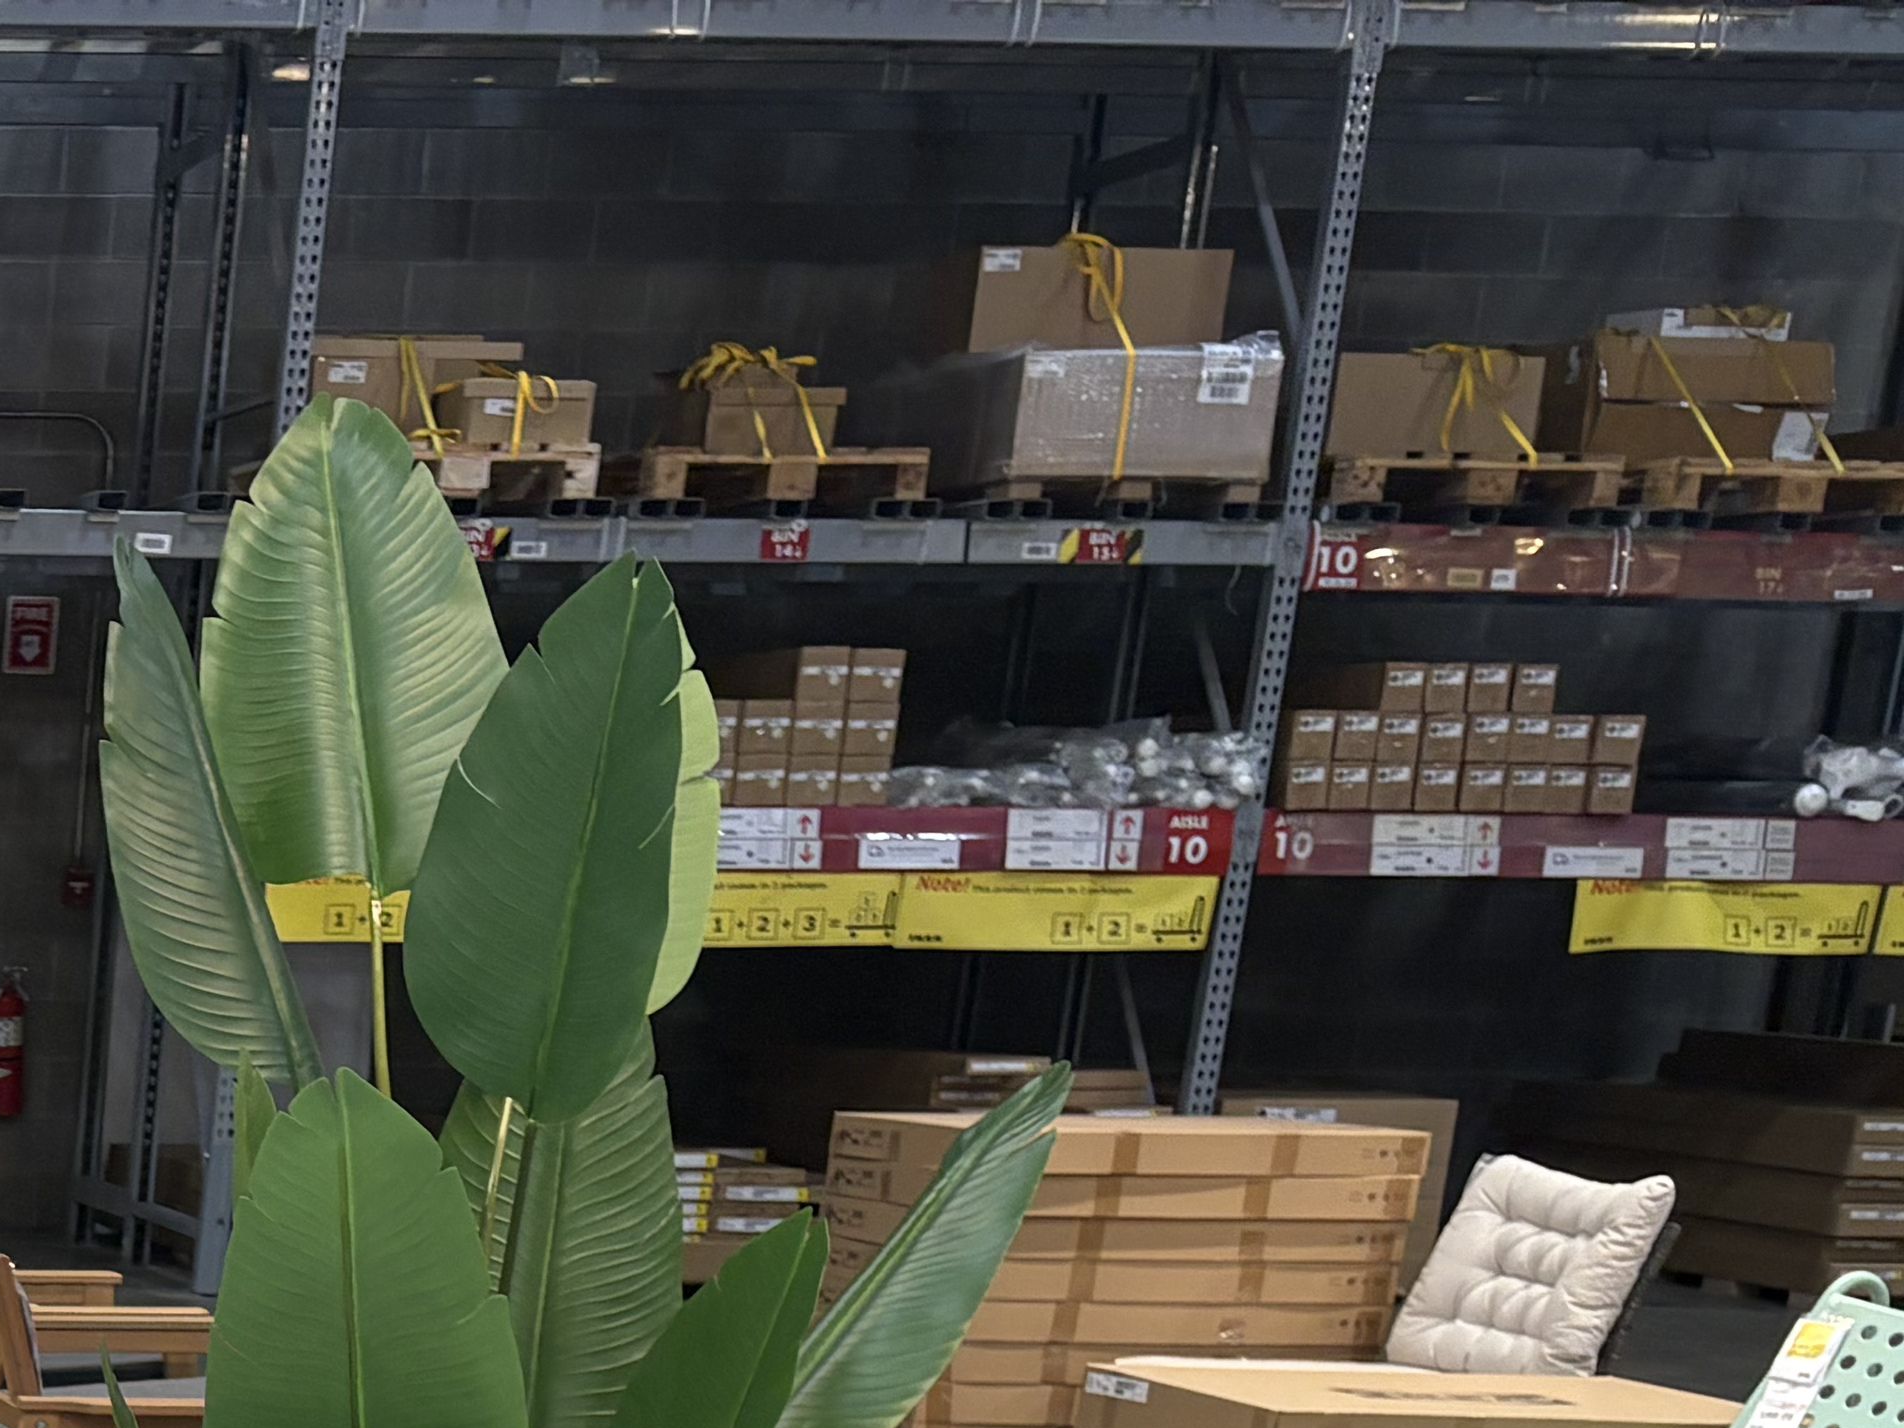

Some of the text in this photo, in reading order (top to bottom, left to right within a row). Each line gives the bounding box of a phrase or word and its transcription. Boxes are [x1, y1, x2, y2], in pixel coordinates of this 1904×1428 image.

[1088, 531, 1118, 546] BIN
[1319, 545, 1358, 574] 10
[1169, 815, 1209, 830] AISLE
[1167, 835, 1209, 864] 10
[1274, 830, 1314, 860] 10
[916, 875, 971, 893] Note!
[333, 911, 346, 928] 1
[379, 911, 393, 928] 2
[713, 916, 723, 933] 1
[756, 915, 770, 933] 2
[802, 915, 817, 933] 3
[1062, 920, 1073, 937] 1
[1107, 920, 1122, 937] 2
[1732, 922, 1742, 938] 1
[1774, 923, 1786, 940] 2
